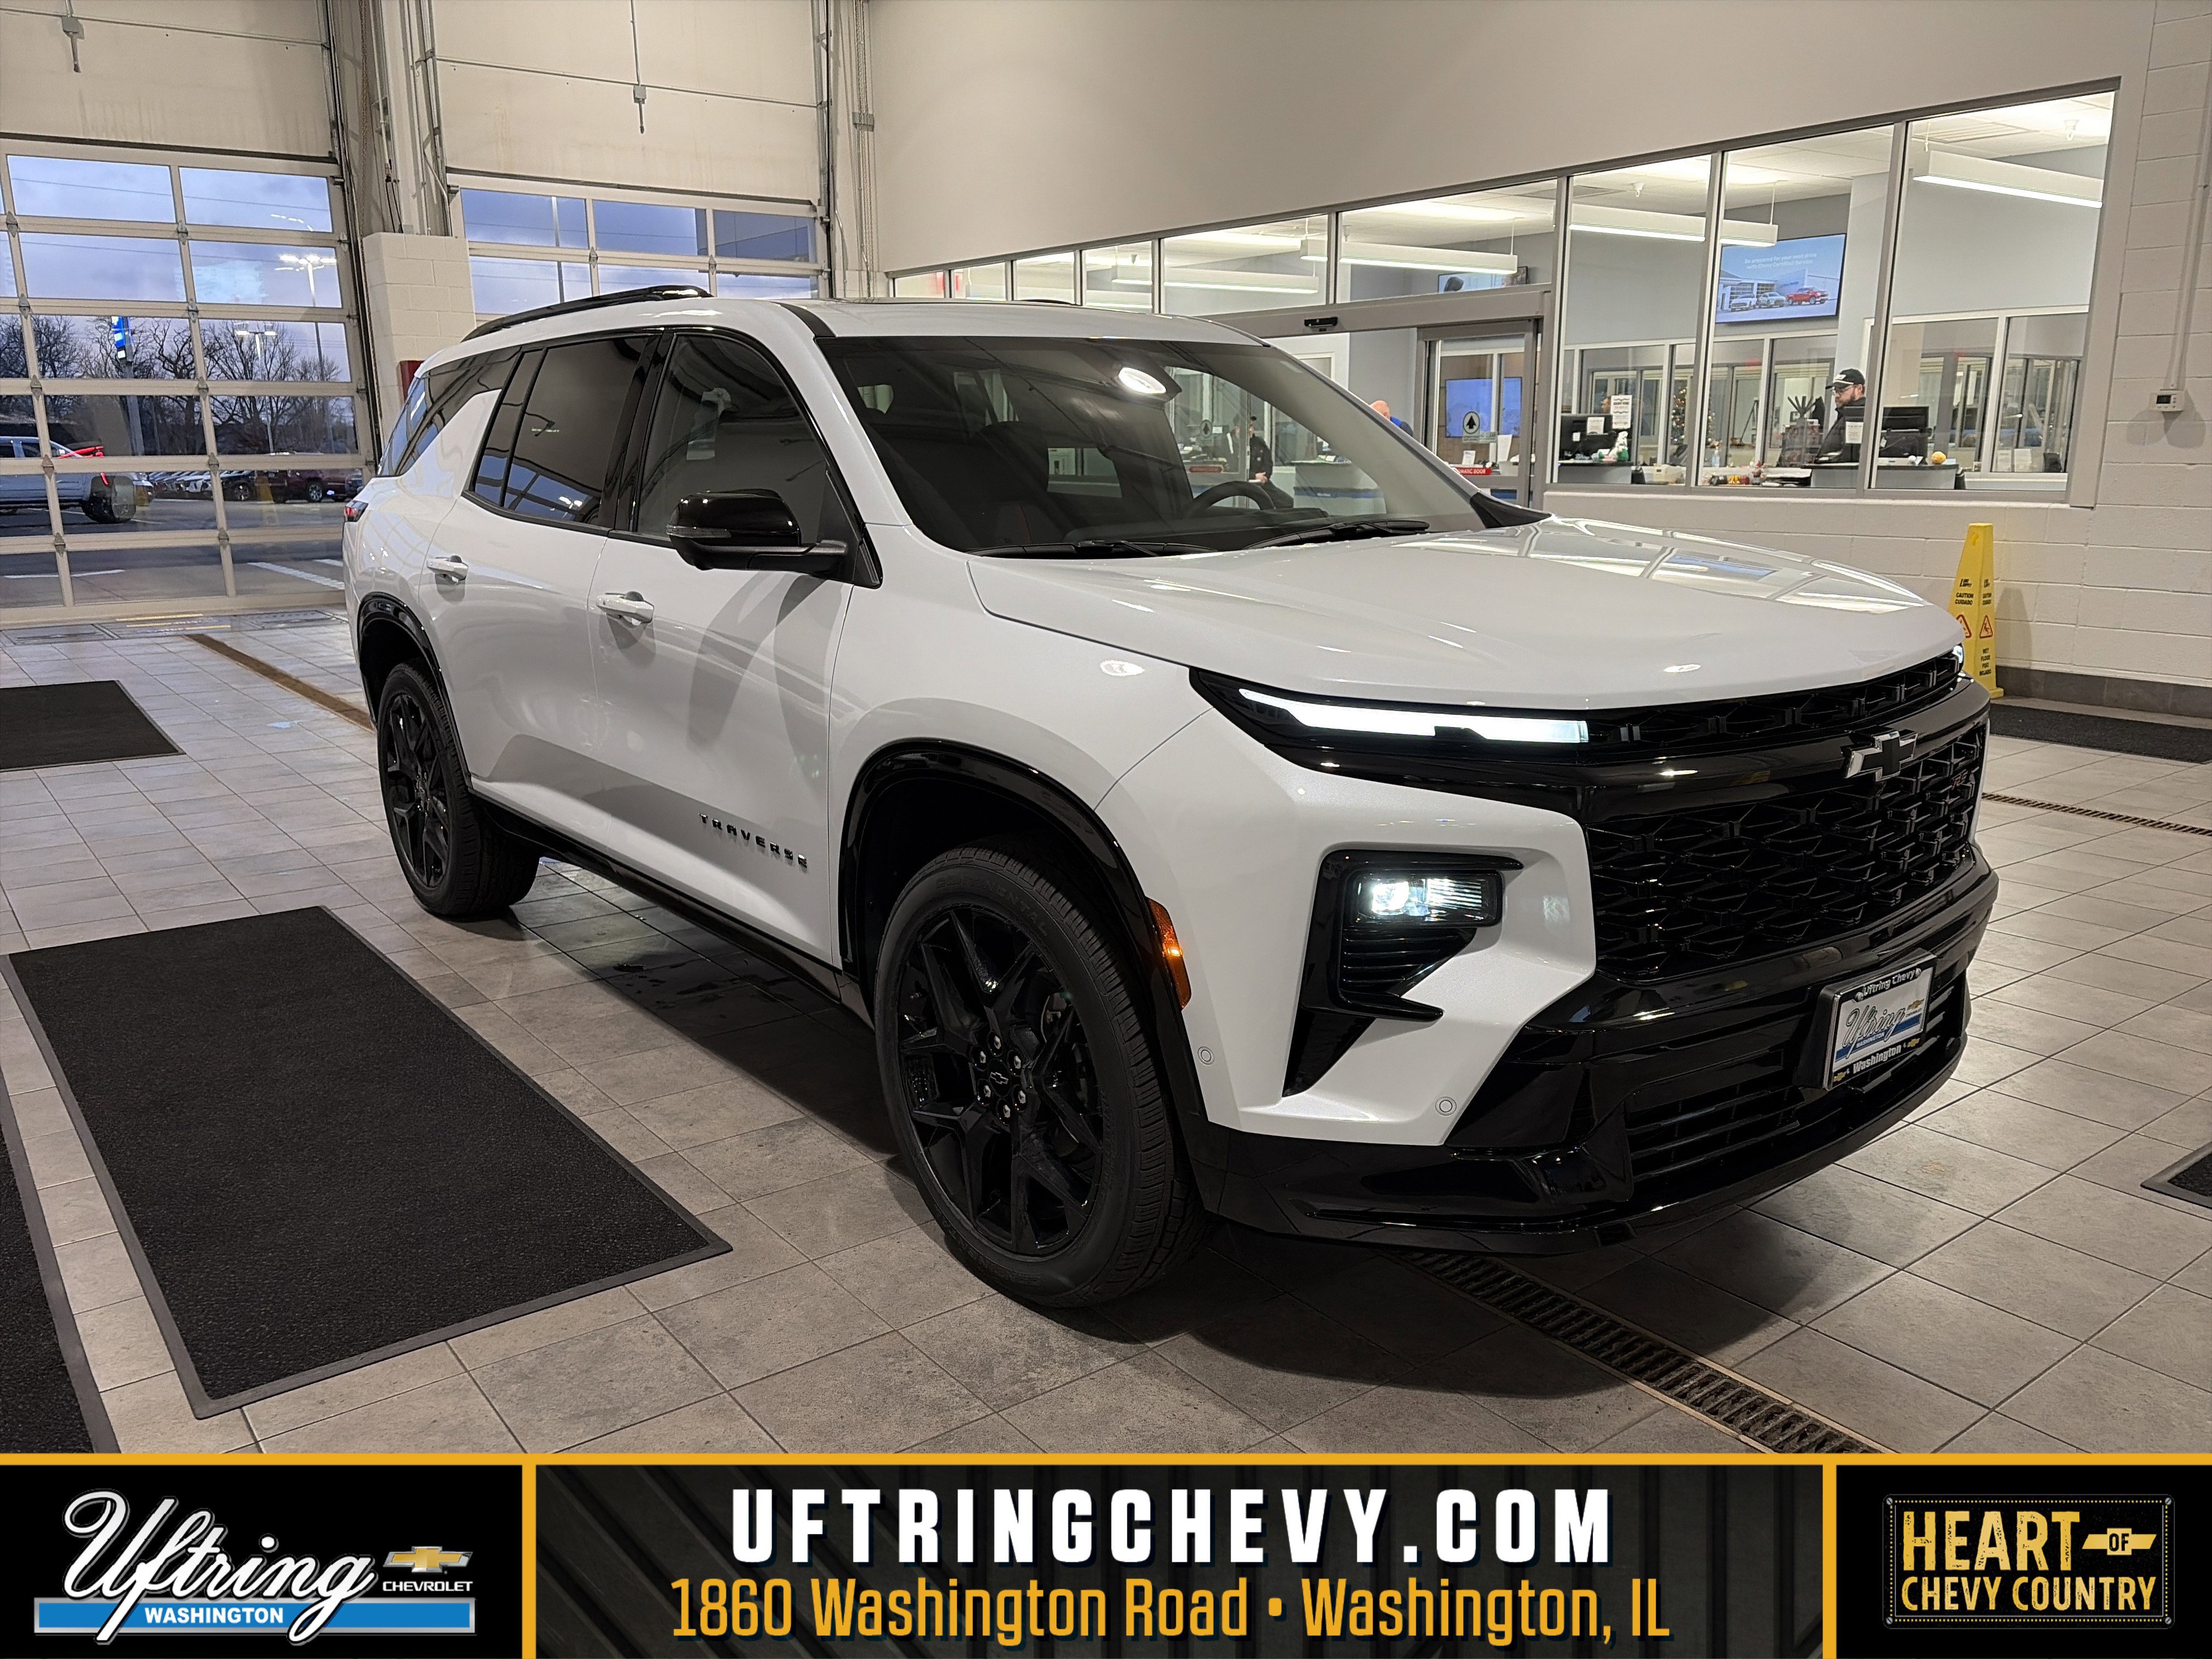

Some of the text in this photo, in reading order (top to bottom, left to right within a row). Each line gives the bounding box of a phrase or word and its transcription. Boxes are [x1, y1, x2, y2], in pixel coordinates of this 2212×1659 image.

[698, 813, 808, 868] TRAVERSE
[1863, 969, 1915, 996] Uftring Chevy
[1843, 1005, 1906, 1059] Uftring
[1856, 1031, 1885, 1048] WASHINGTON
[1853, 1044, 1901, 1074] Washington
